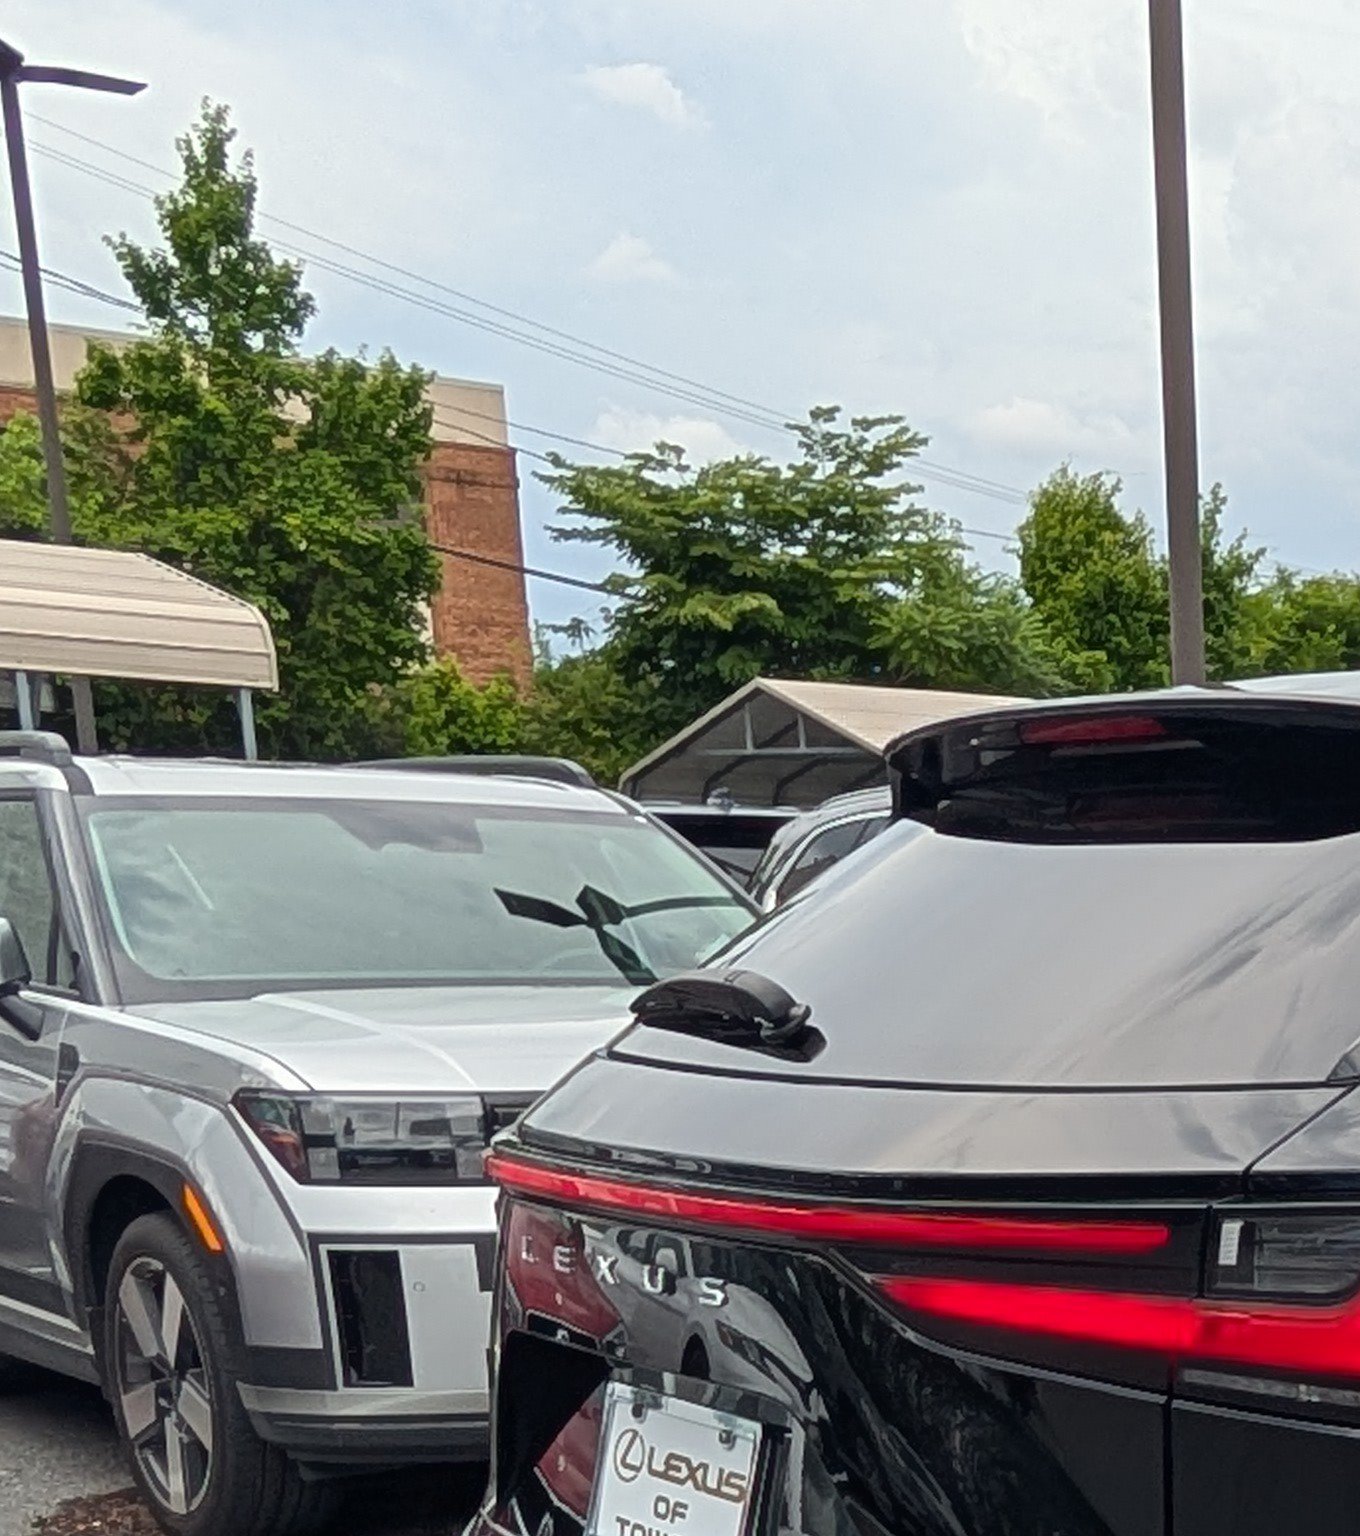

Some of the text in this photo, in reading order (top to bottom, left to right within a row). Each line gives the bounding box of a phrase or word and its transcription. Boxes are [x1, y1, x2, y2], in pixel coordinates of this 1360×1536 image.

[521, 1235, 726, 1306] LEXUS
[647, 1446, 748, 1503] LEXUS
[653, 1495, 689, 1523] OF
